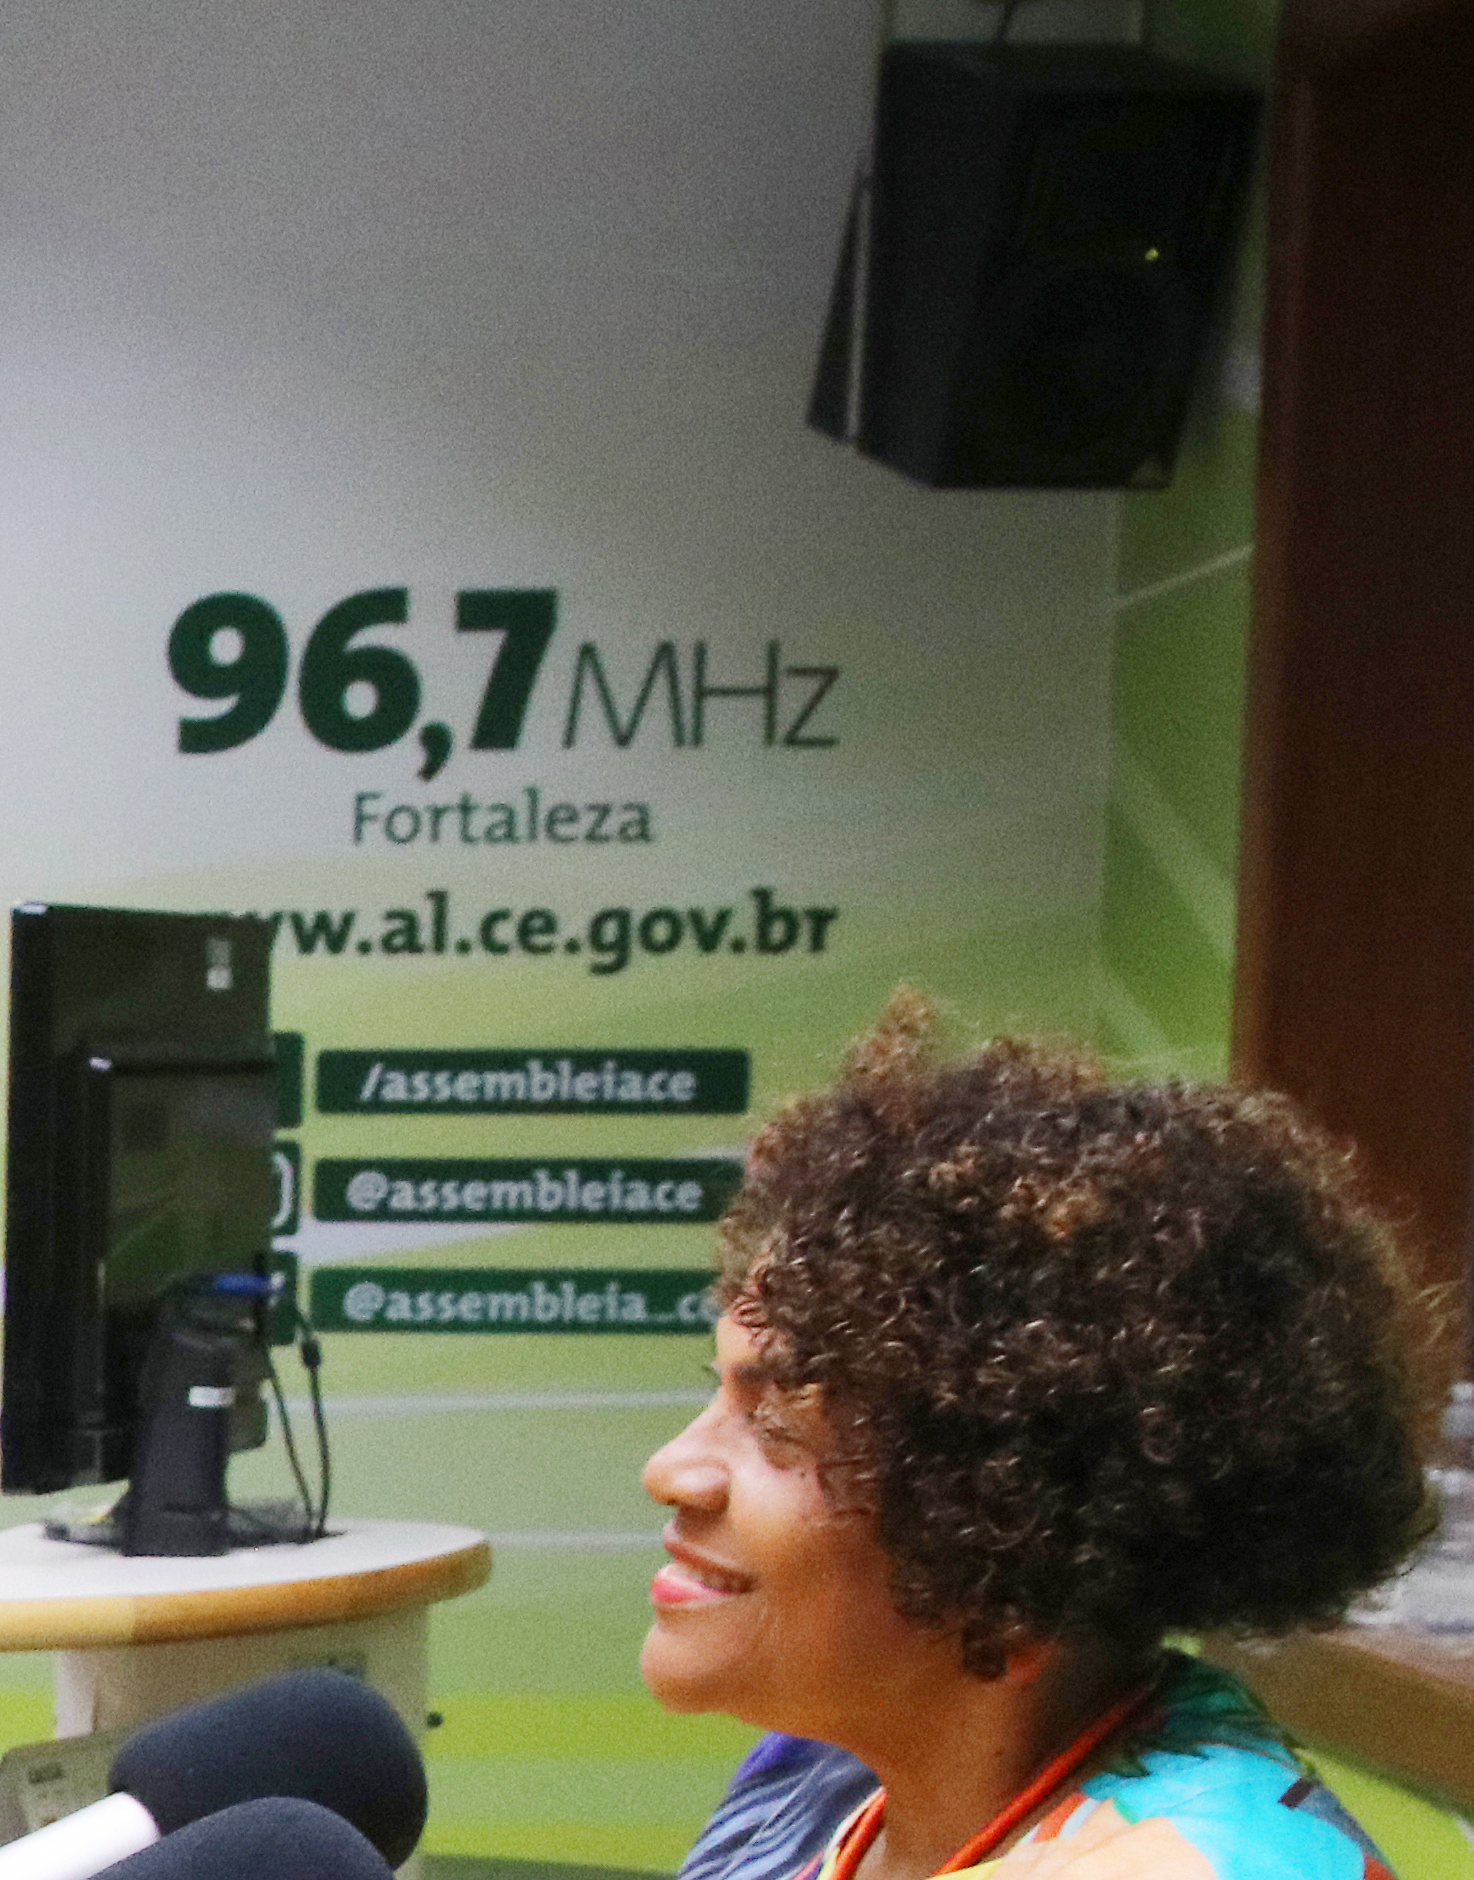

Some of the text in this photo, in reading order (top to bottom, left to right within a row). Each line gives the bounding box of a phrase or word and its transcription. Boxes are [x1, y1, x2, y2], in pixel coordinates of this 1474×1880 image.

[168, 587, 841, 781] 96,7 MHz
[353, 786, 656, 846] Fortaleza
[360, 1060, 697, 1103] /assembleiace
[346, 1168, 704, 1213] @assembleiace
